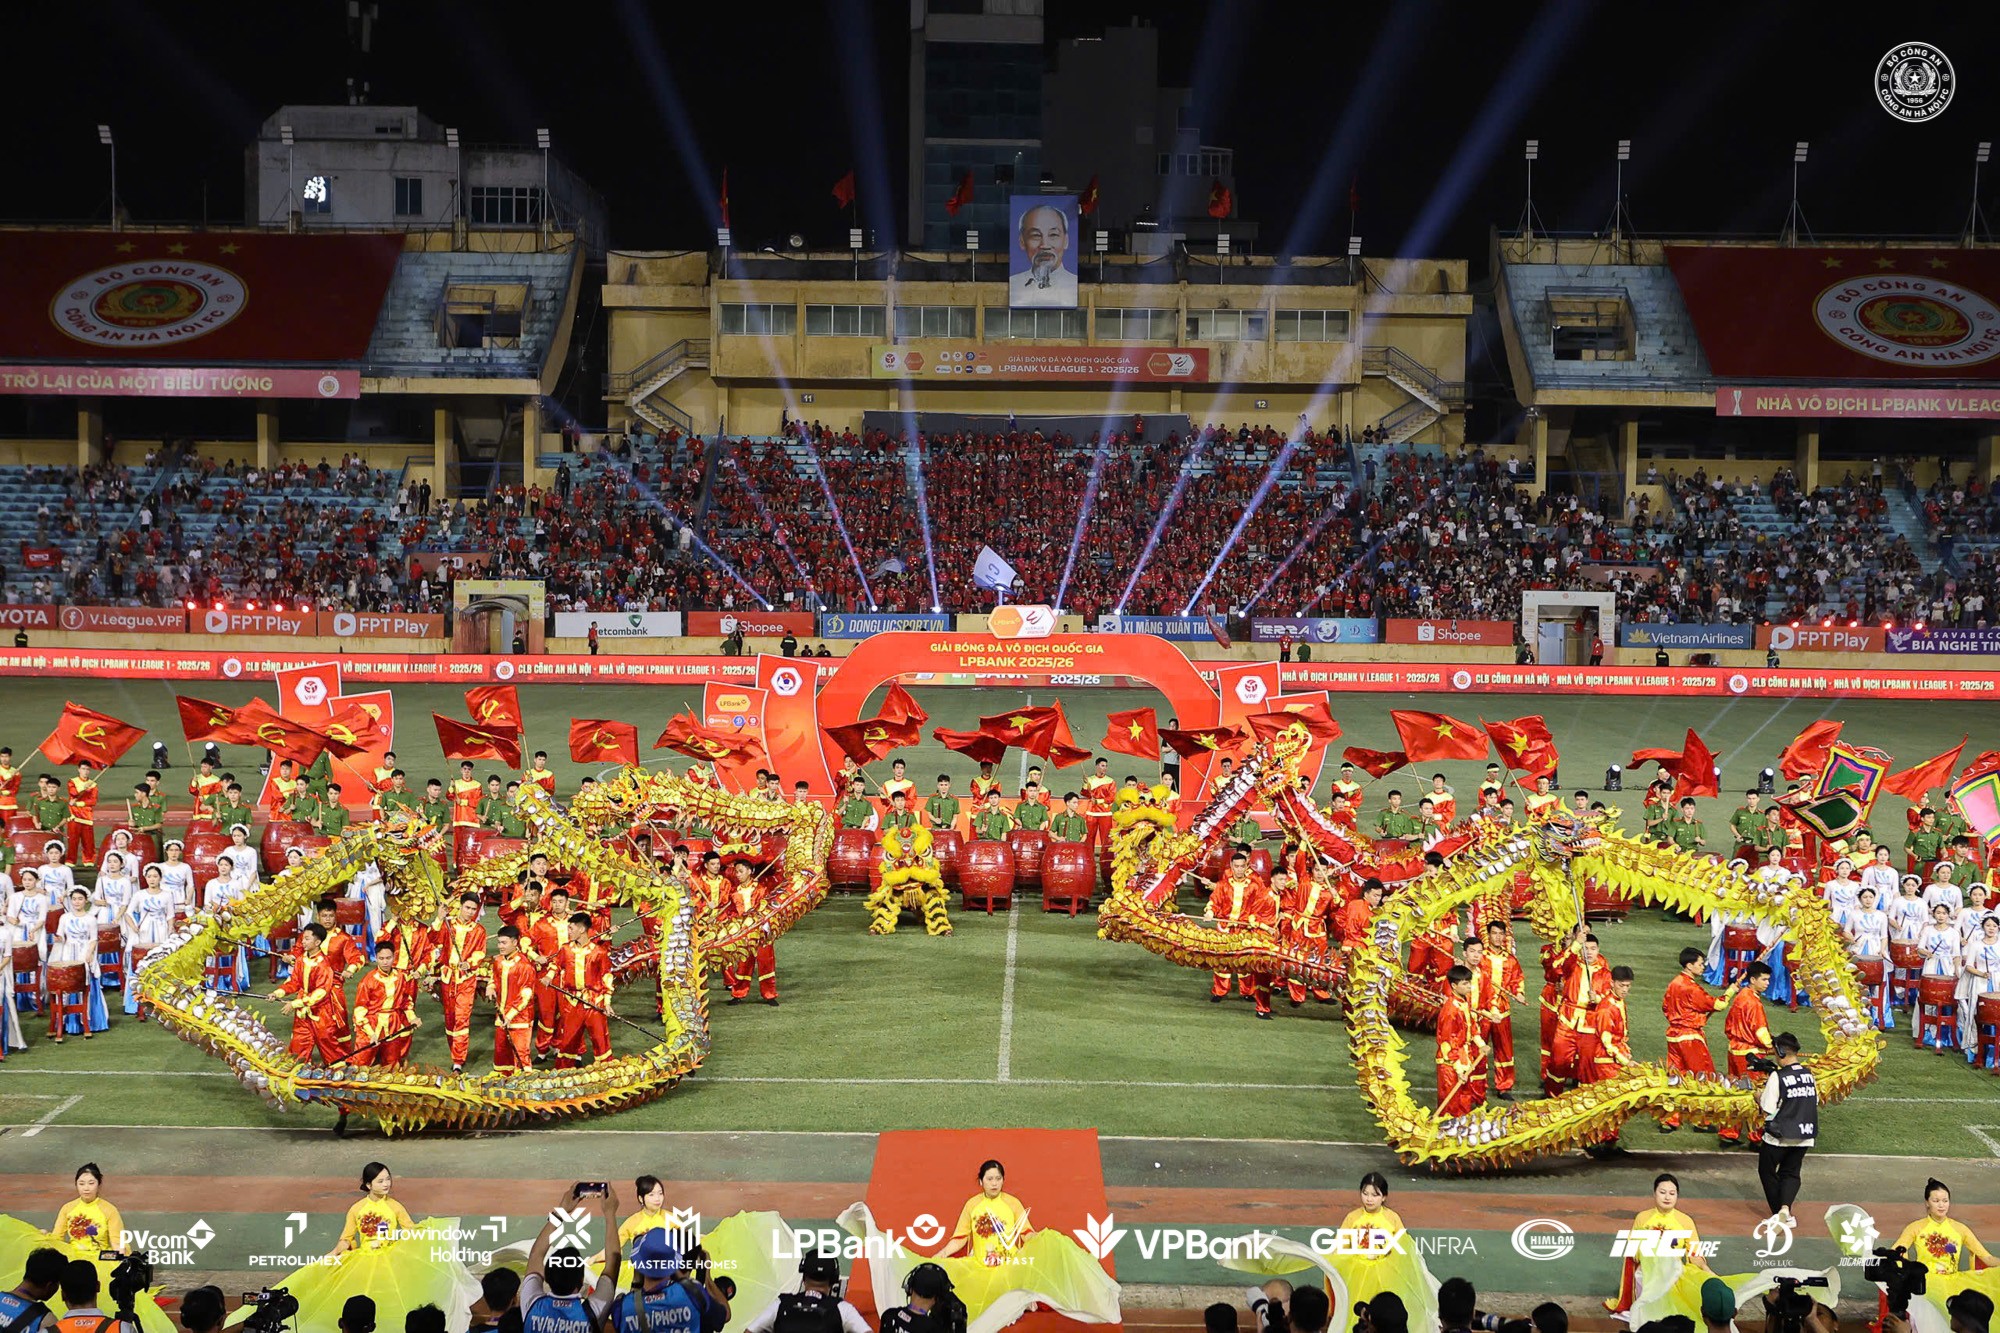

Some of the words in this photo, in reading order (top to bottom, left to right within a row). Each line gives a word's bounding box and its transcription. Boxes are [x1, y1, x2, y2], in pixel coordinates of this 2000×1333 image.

[132, 265, 196, 276] CÔNG
[197, 273, 224, 287] AN
[1836, 288, 1862, 303] BỘ
[1863, 279, 1926, 292] CÔNG
[1934, 288, 1966, 302] AN
[64, 307, 98, 333] CÔNG
[95, 330, 126, 340] AN
[202, 310, 225, 324] FC
[1839, 326, 1890, 353] CÔNG
[1894, 349, 1925, 360] AN
[1100, 366, 1140, 374] 2025/26
[2, 371, 40, 387] TRỞ
[43, 375, 73, 392] LẠI
[76, 370, 114, 389] CỦA
[119, 372, 158, 393] MỘT
[210, 376, 273, 395] TƯỢNG
[1756, 394, 1793, 410] NHÀ
[1797, 394, 1822, 410] VÔ
[1825, 398, 1868, 414] ĐỊCH
[1872, 398, 1942, 412] LPBANK
[90, 613, 183, 629] V.League.VPF
[231, 616, 263, 630] FPT
[266, 616, 302, 634] Play
[359, 618, 392, 632] FPT
[394, 618, 430, 637] Play
[740, 620, 784, 634] Shopee
[1124, 622, 1133, 634] XI
[1136, 618, 1163, 634] MĂNG
[1165, 620, 1190, 634] XUÂN
[1254, 625, 1310, 634] TERRA
[1438, 628, 1482, 643] Shopee
[1651, 632, 1700, 644] Vietnam
[1700, 633, 1744, 644] Airlines
[1798, 631, 1830, 646] FPT
[1834, 631, 1870, 650] Play
[1912, 640, 1935, 650] BIA
[1940, 641, 1978, 651] NGHE
[930, 641, 952, 652] GIẢI
[954, 640, 984, 652] BÓNG
[988, 642, 1003, 653] ĐÁ
[1006, 642, 1022, 653] VÔ
[1024, 644, 1050, 654] ĐỊCH
[1052, 642, 1083, 653] QUỐC
[1086, 644, 1104, 653] GIA
[10, 657, 20, 667] AN
[21, 656, 32, 668] HÀ
[34, 656, 46, 670] NỘI
[53, 656, 68, 668] NHÀ
[70, 656, 80, 668] VÔ
[82, 658, 98, 670] ĐỊCH
[100, 658, 128, 669] LPBANK
[130, 659, 164, 670] V.LEAGUE
[177, 660, 210, 670] 2025/26
[246, 662, 260, 671] CLB
[262, 660, 280, 672] CÔNG
[343, 660, 352, 673] VÔ
[354, 663, 372, 676] ĐỊCH
[374, 664, 401, 674] LPBANK
[403, 664, 436, 674] V.LEAGUE
[450, 664, 482, 674] 2025/26
[518, 664, 532, 674] CLB
[534, 662, 552, 674] CÔNG
[555, 664, 566, 674] AN
[567, 662, 578, 674] HÀ
[579, 662, 592, 676] NỘI
[599, 662, 614, 674] NHÀ
[616, 662, 626, 674] VÔ
[628, 664, 644, 676] ĐỊCH
[646, 665, 674, 674] LPBANK
[676, 665, 710, 675] V.LEAGUE
[722, 666, 756, 675] 2025/26
[960, 656, 1016, 667] LPBANK
[1019, 657, 1074, 668] 2025/26
[1050, 675, 1100, 685] 2025/26
[1200, 671, 1214, 680] CLB
[1282, 670, 1296, 682] NHÀ
[1299, 670, 1308, 682] VÔ
[1310, 673, 1328, 685] ĐỊCH
[1330, 672, 1358, 682] LPBANK
[1360, 673, 1394, 683] V.LEAGUE
[1406, 674, 1440, 683] 2025/26
[1476, 674, 1490, 684] CLB
[1492, 672, 1510, 684] CÔNG
[1512, 674, 1524, 684] AN
[1525, 672, 1535, 684] HÀ
[1537, 672, 1550, 686] NỘI
[1556, 673, 1572, 684] NHÀ
[1574, 673, 1584, 685] VÔ
[1586, 676, 1603, 688] ĐỊCH
[1605, 676, 1633, 685] LPBANK
[1636, 676, 1670, 686] V.LEAGUE
[1682, 676, 1716, 686] 2025/26
[1752, 678, 1766, 688] CLB
[1768, 676, 1788, 688] CÔNG
[1790, 678, 1800, 688] AN
[1802, 676, 1812, 688] HÀ
[1814, 676, 1826, 690] NỘI
[1834, 677, 1850, 689] NHÀ
[1852, 677, 1861, 689] VÔ
[1864, 679, 1880, 690] ĐỊCH
[1882, 679, 1911, 690] LPBANK
[1913, 680, 1947, 690] V.LEAGUE
[1960, 680, 1994, 690] 2025/26
